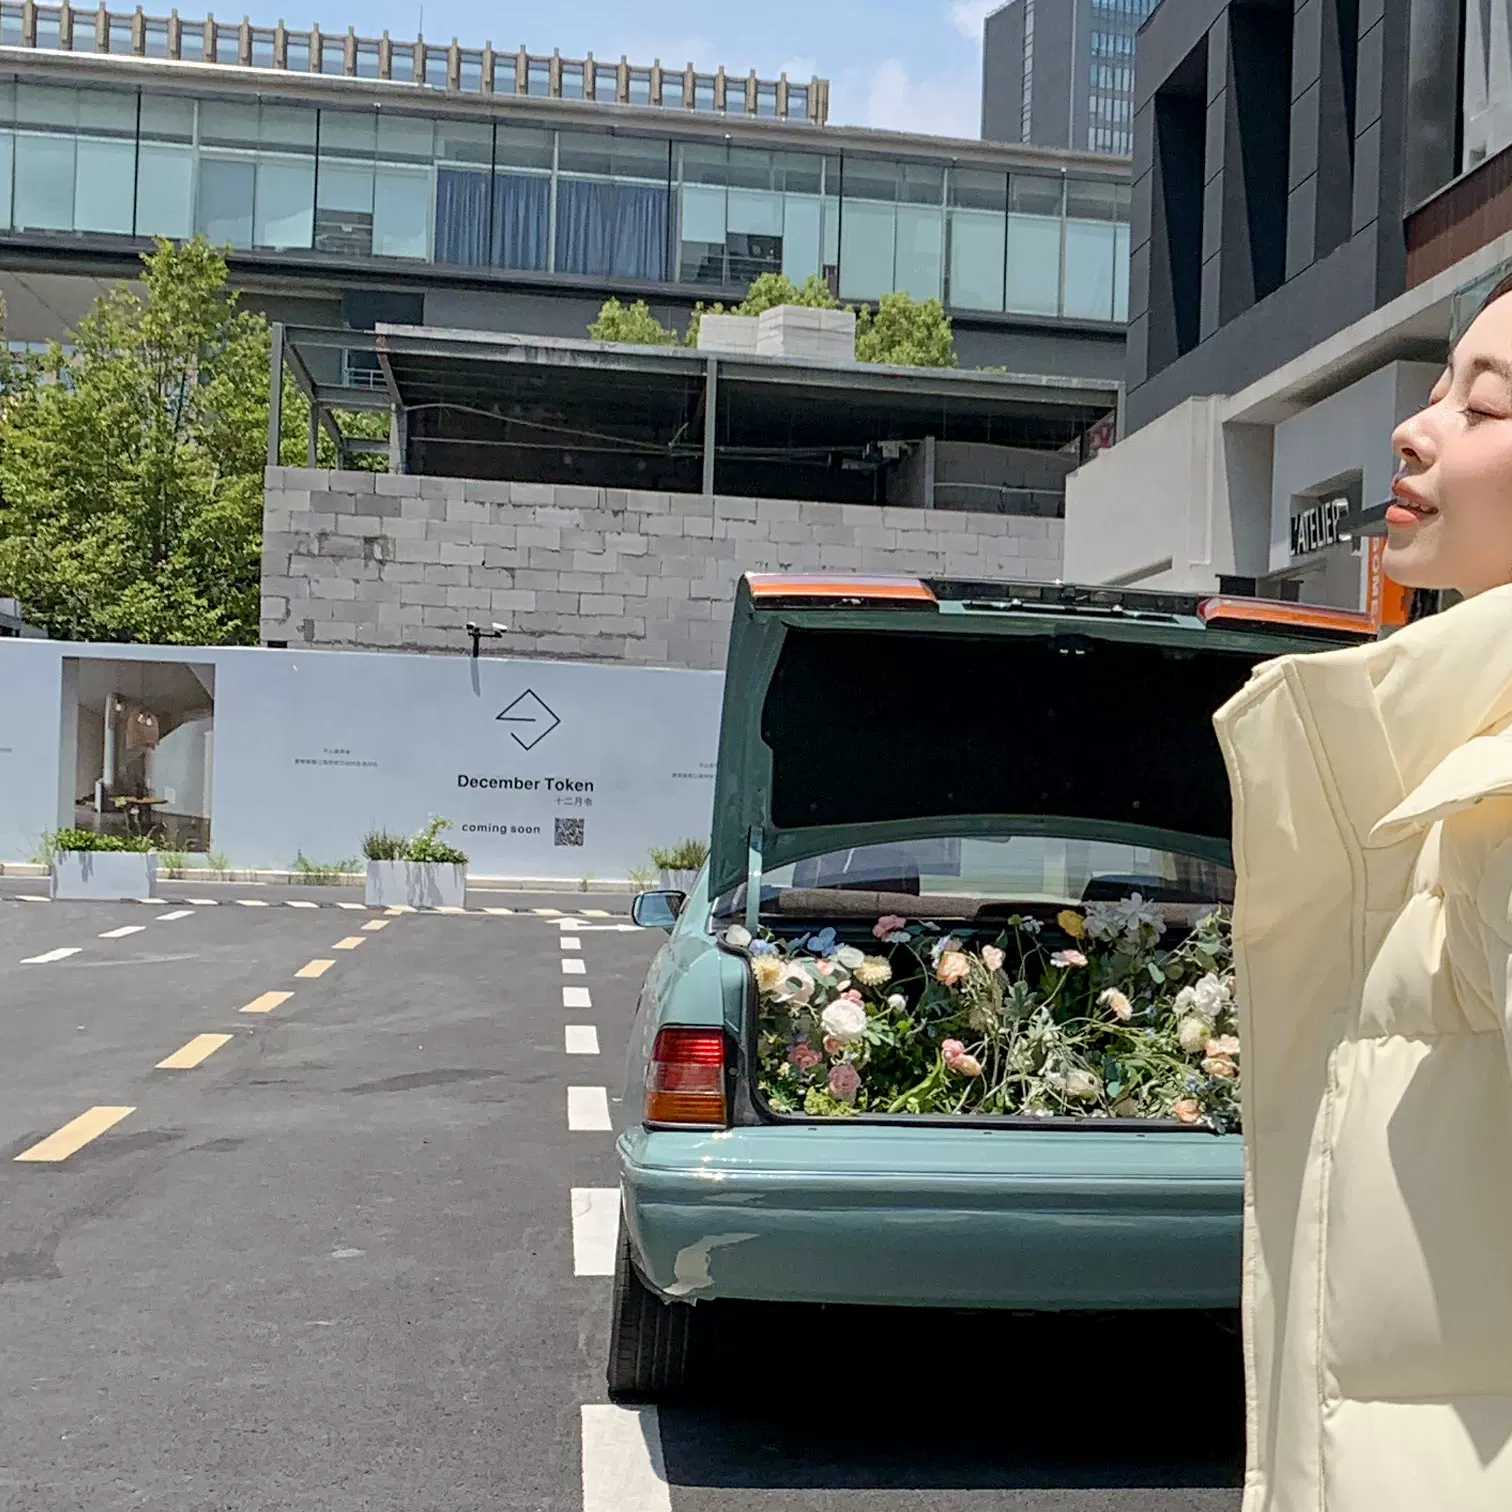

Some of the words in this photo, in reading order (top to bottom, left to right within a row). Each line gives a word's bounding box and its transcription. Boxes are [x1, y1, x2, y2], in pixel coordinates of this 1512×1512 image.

[457, 774, 540, 790] December
[544, 777, 594, 792] Token
[461, 823, 507, 835] coming
[510, 825, 541, 834] soon
